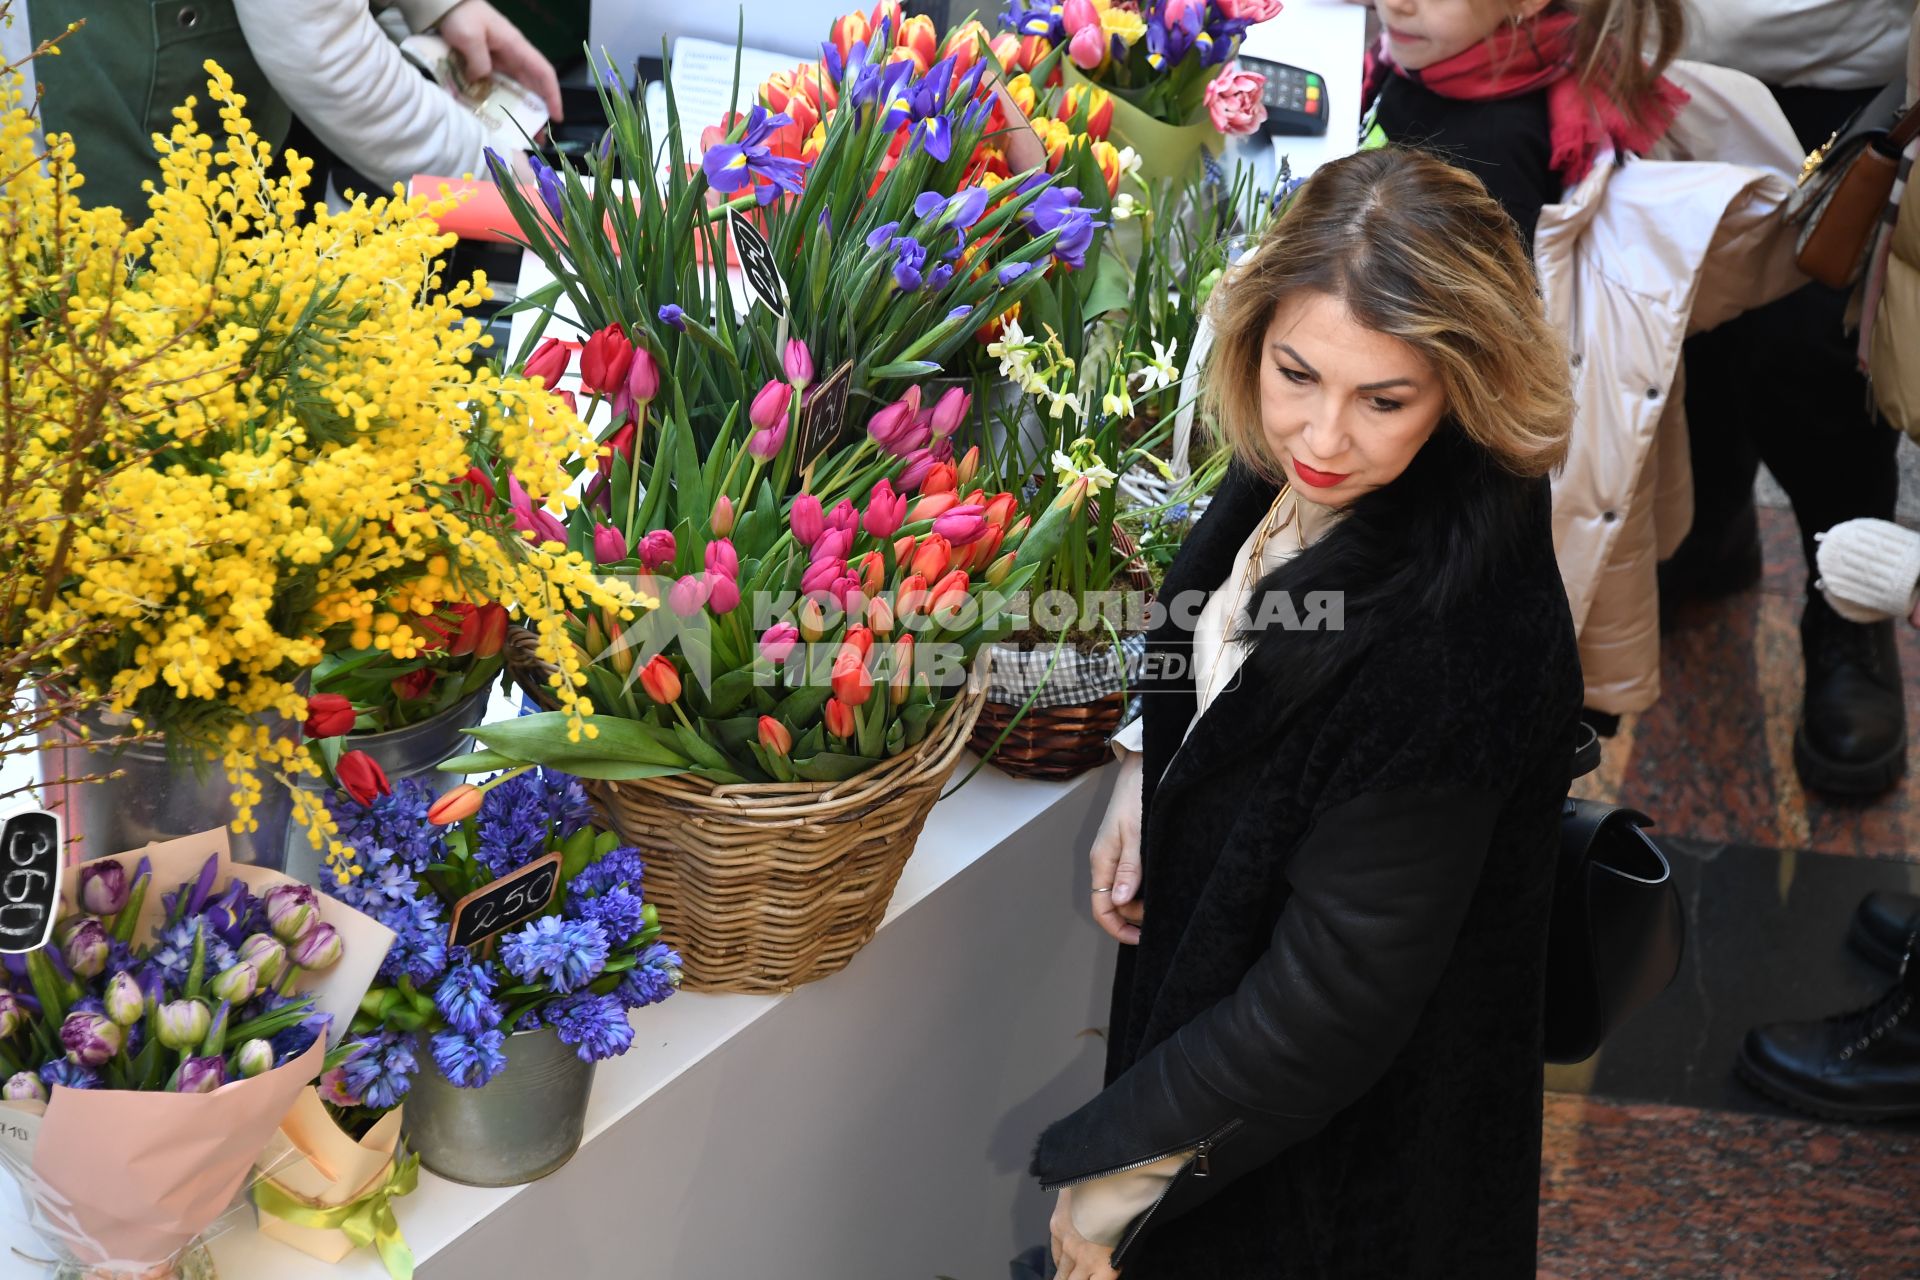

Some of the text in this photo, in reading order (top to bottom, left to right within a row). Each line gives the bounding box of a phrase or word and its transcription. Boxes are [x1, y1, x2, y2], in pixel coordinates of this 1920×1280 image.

[812, 376, 848, 449] 130
[0, 830, 49, 936] 360
[469, 871, 553, 936] 250
